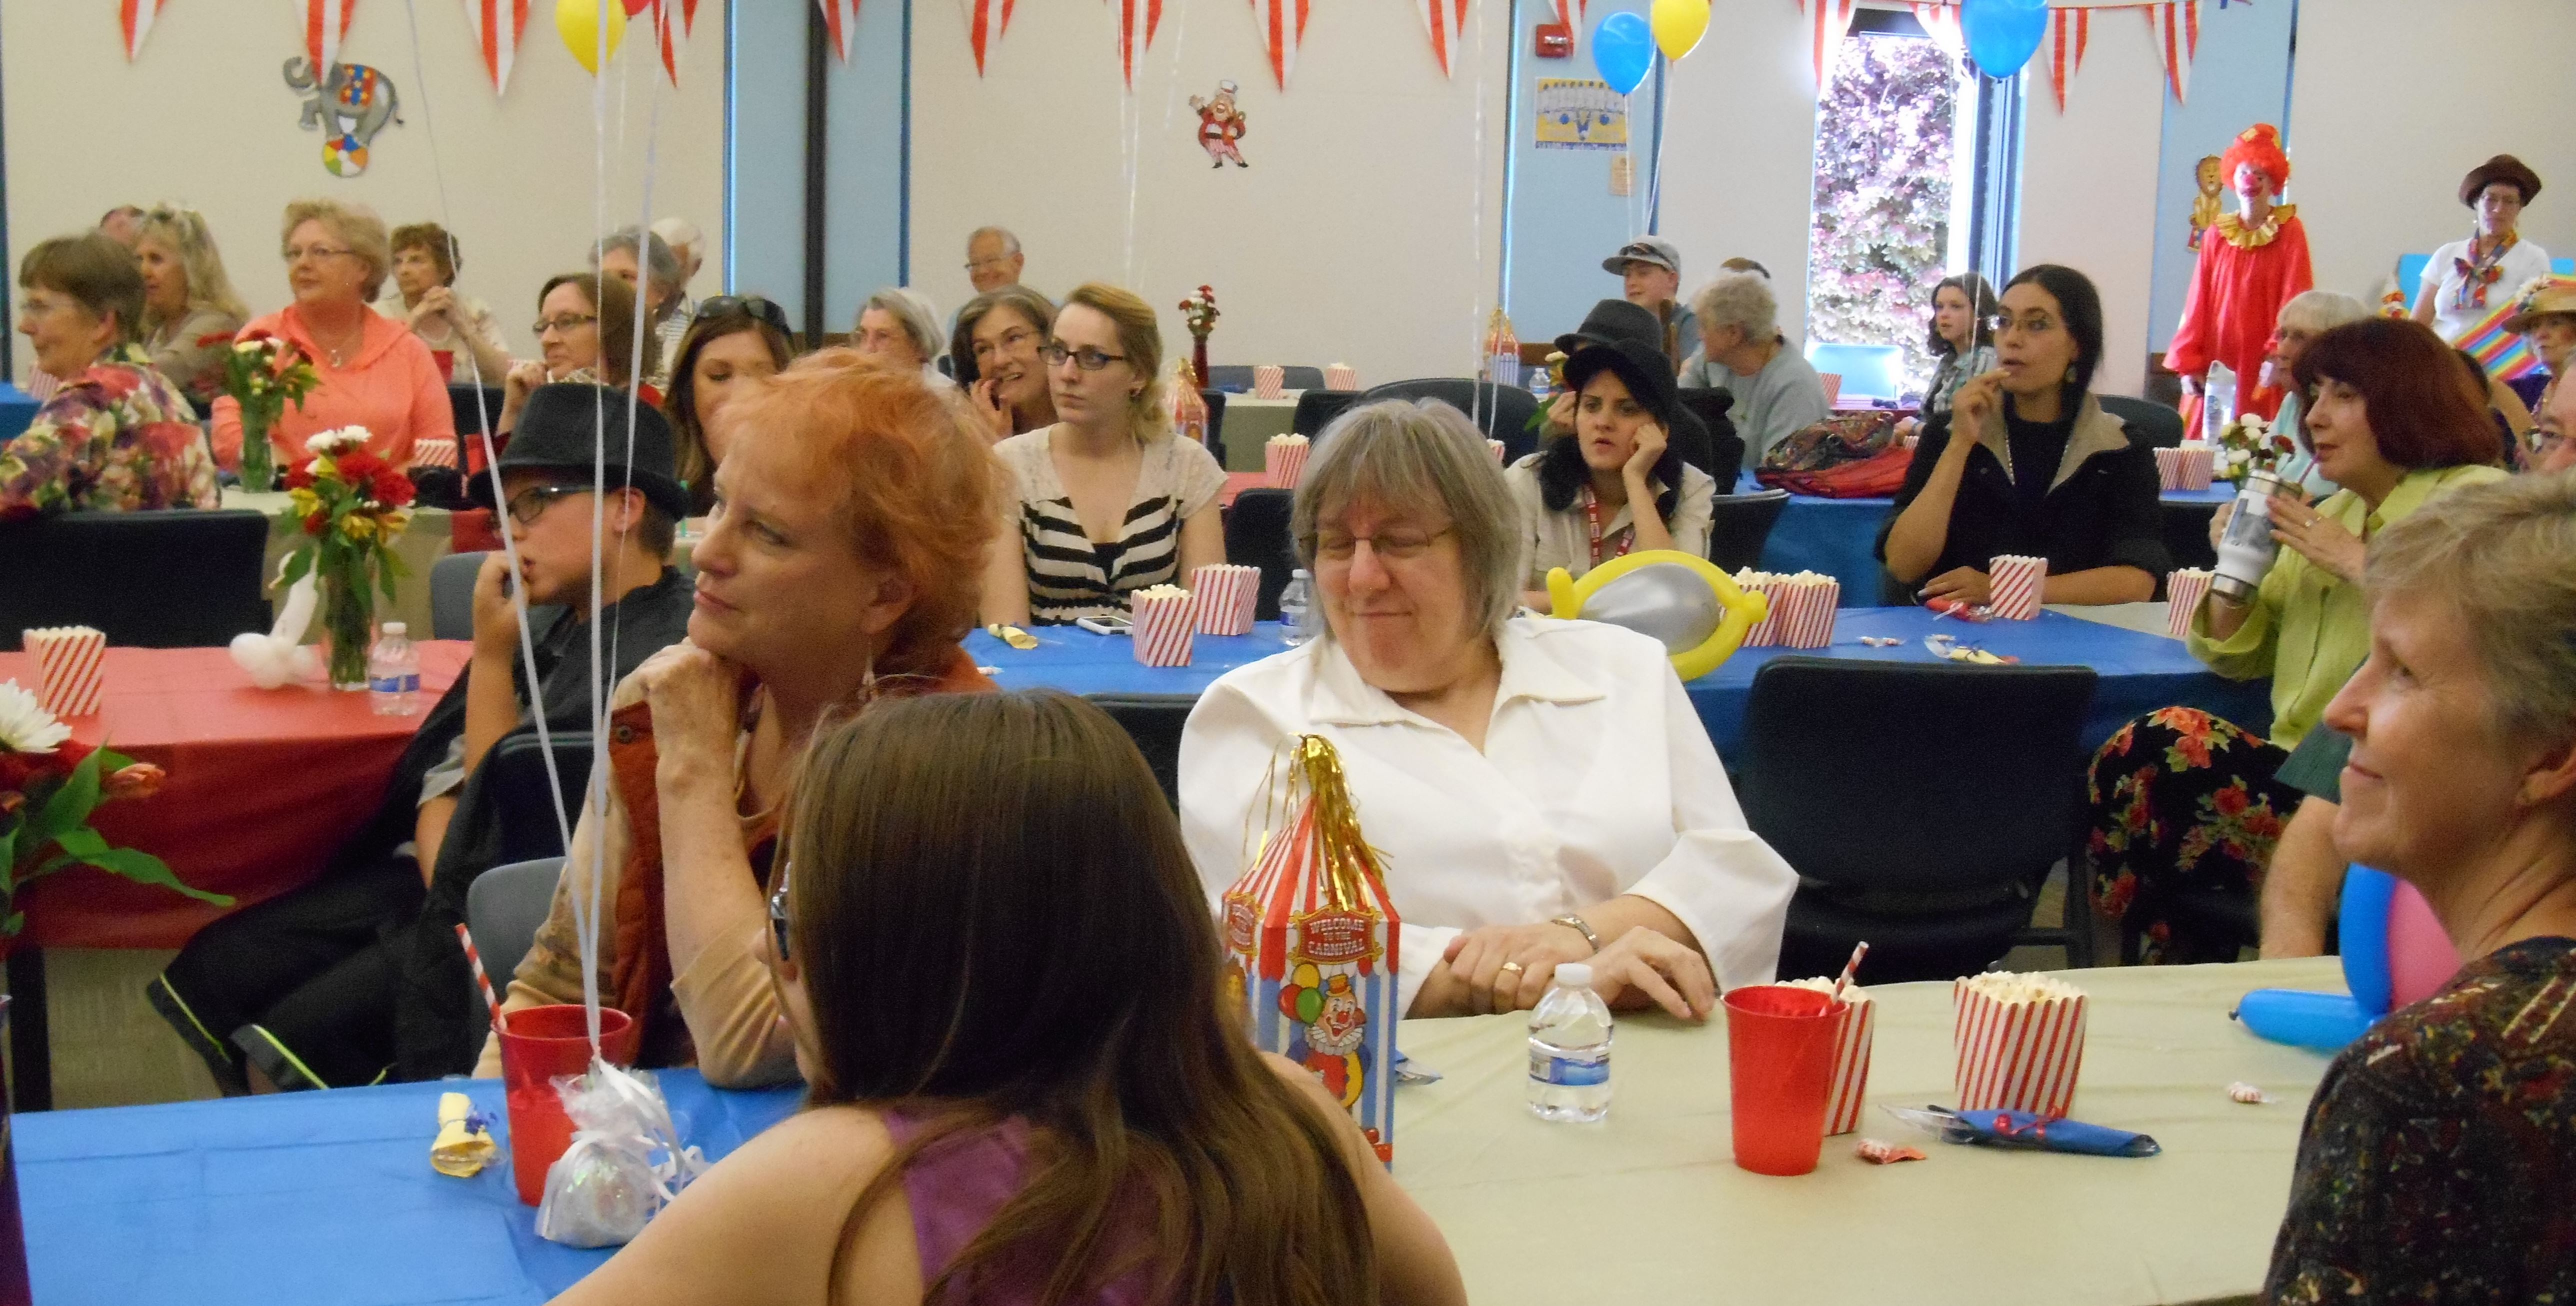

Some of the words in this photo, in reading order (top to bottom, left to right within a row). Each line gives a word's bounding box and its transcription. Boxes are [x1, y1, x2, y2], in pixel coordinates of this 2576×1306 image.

[1309, 918, 1364, 934] WELCOME
[1335, 931, 1351, 940] THE
[1308, 938, 1365, 956] CARNIVAL
